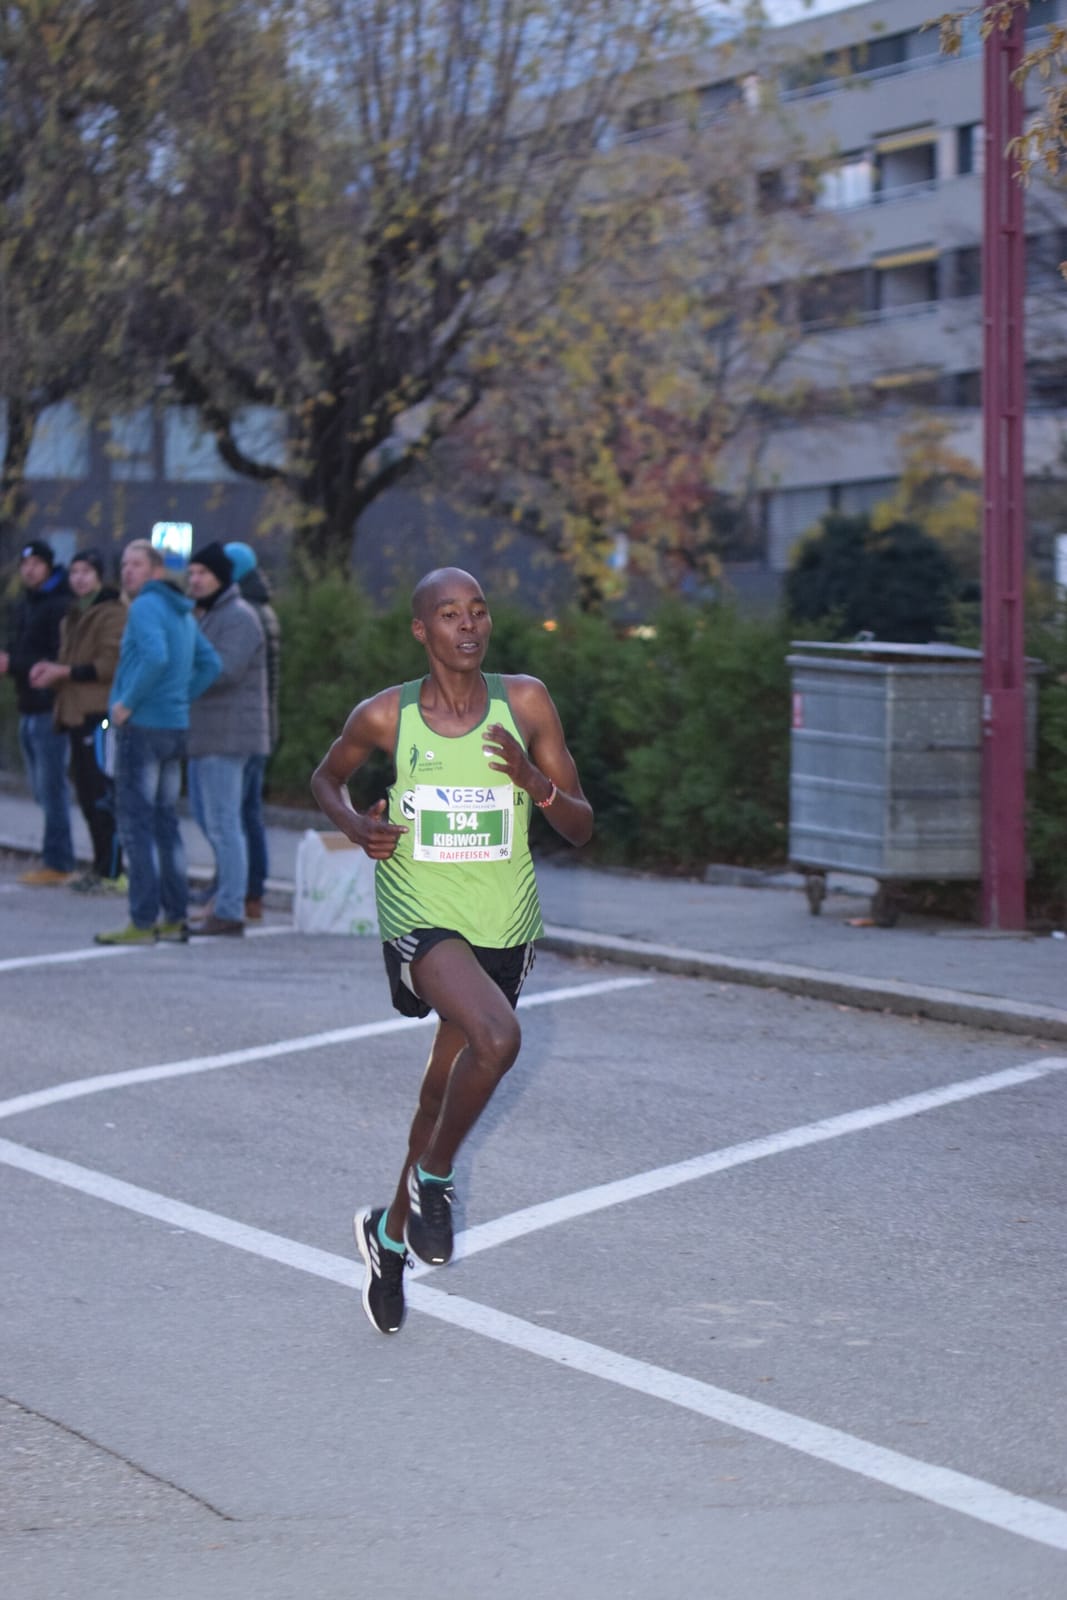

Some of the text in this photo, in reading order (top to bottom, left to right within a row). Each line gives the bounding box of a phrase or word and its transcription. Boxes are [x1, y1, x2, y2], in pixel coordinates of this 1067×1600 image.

[452, 789, 496, 803] GESA
[446, 812, 479, 831] 194
[433, 833, 490, 846] KIBIWOTT
[439, 851, 490, 861] RAIFFEISEN
[499, 848, 509, 857] 96
